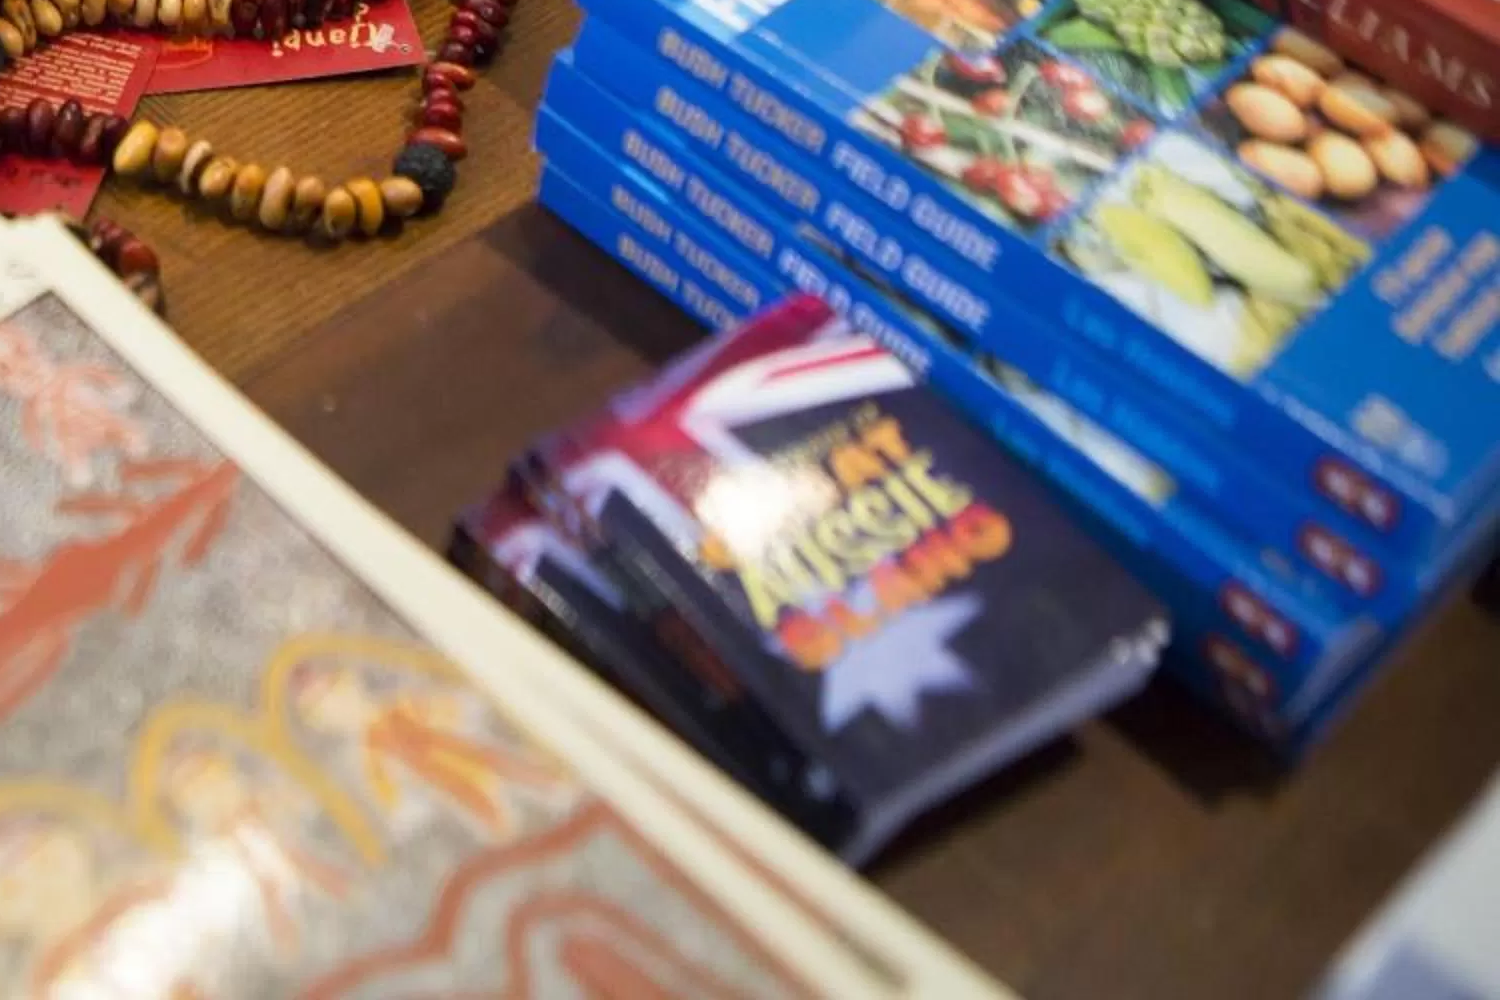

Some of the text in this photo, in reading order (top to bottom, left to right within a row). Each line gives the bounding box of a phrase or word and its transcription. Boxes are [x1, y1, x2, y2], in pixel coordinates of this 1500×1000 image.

[621, 128, 687, 191] BUSH
[684, 174, 775, 261] TUCKER
[656, 85, 991, 329] BUSH TUCKER FIELD GUIDE
[657, 26, 1002, 272] BUSH TUCKER FIELD GUIDE
[611, 184, 762, 309] BUSH TUCKER
[617, 232, 738, 331] BUSH TUCK
[735, 446, 976, 631] AUSSIE
